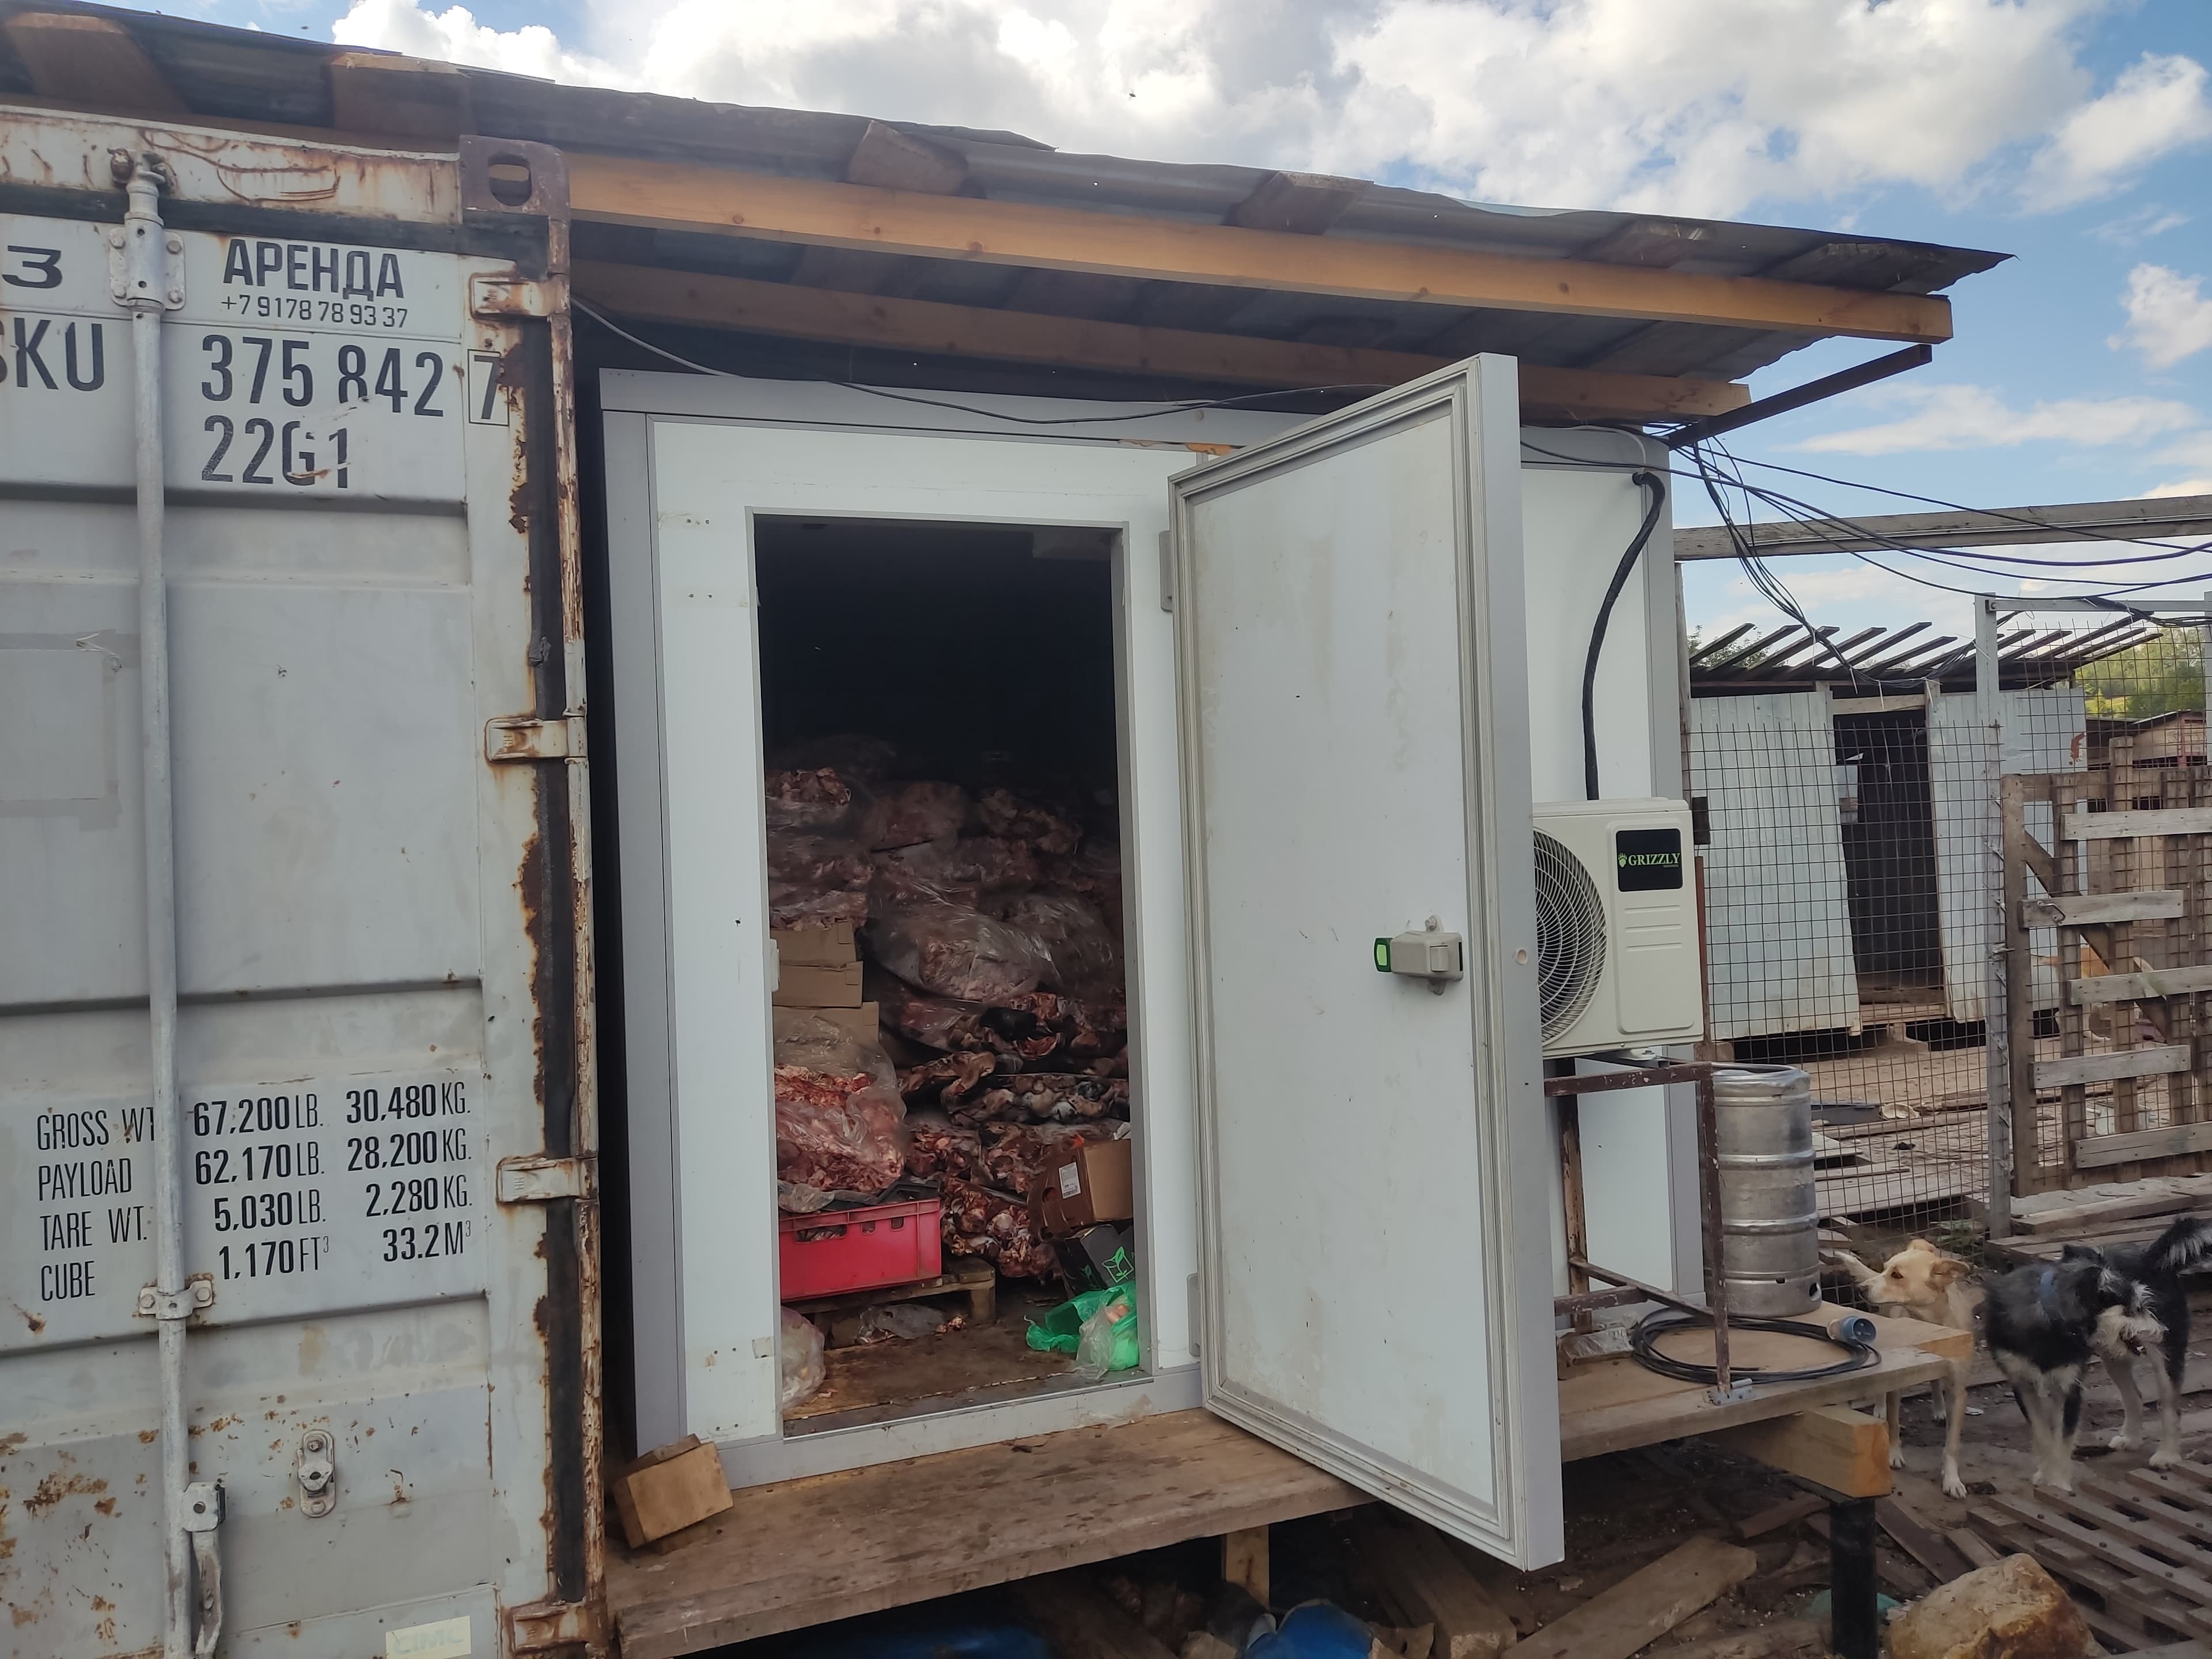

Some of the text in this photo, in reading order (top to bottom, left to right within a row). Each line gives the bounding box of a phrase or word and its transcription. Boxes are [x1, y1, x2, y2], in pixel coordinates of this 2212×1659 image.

[224, 239, 404, 302] АРЕНДА
[0, 317, 105, 392] KU
[202, 334, 313, 407] 375
[338, 344, 444, 418] 842
[202, 415, 348, 489] 22G1
[1628, 853, 1680, 866] GRIZZLY
[37, 1109, 109, 1150] GROSS
[38, 1157, 132, 1202] PAYLOAD
[39, 1211, 93, 1251] TARE
[108, 1205, 147, 1244] WT.
[41, 1260, 96, 1301] CUBE
